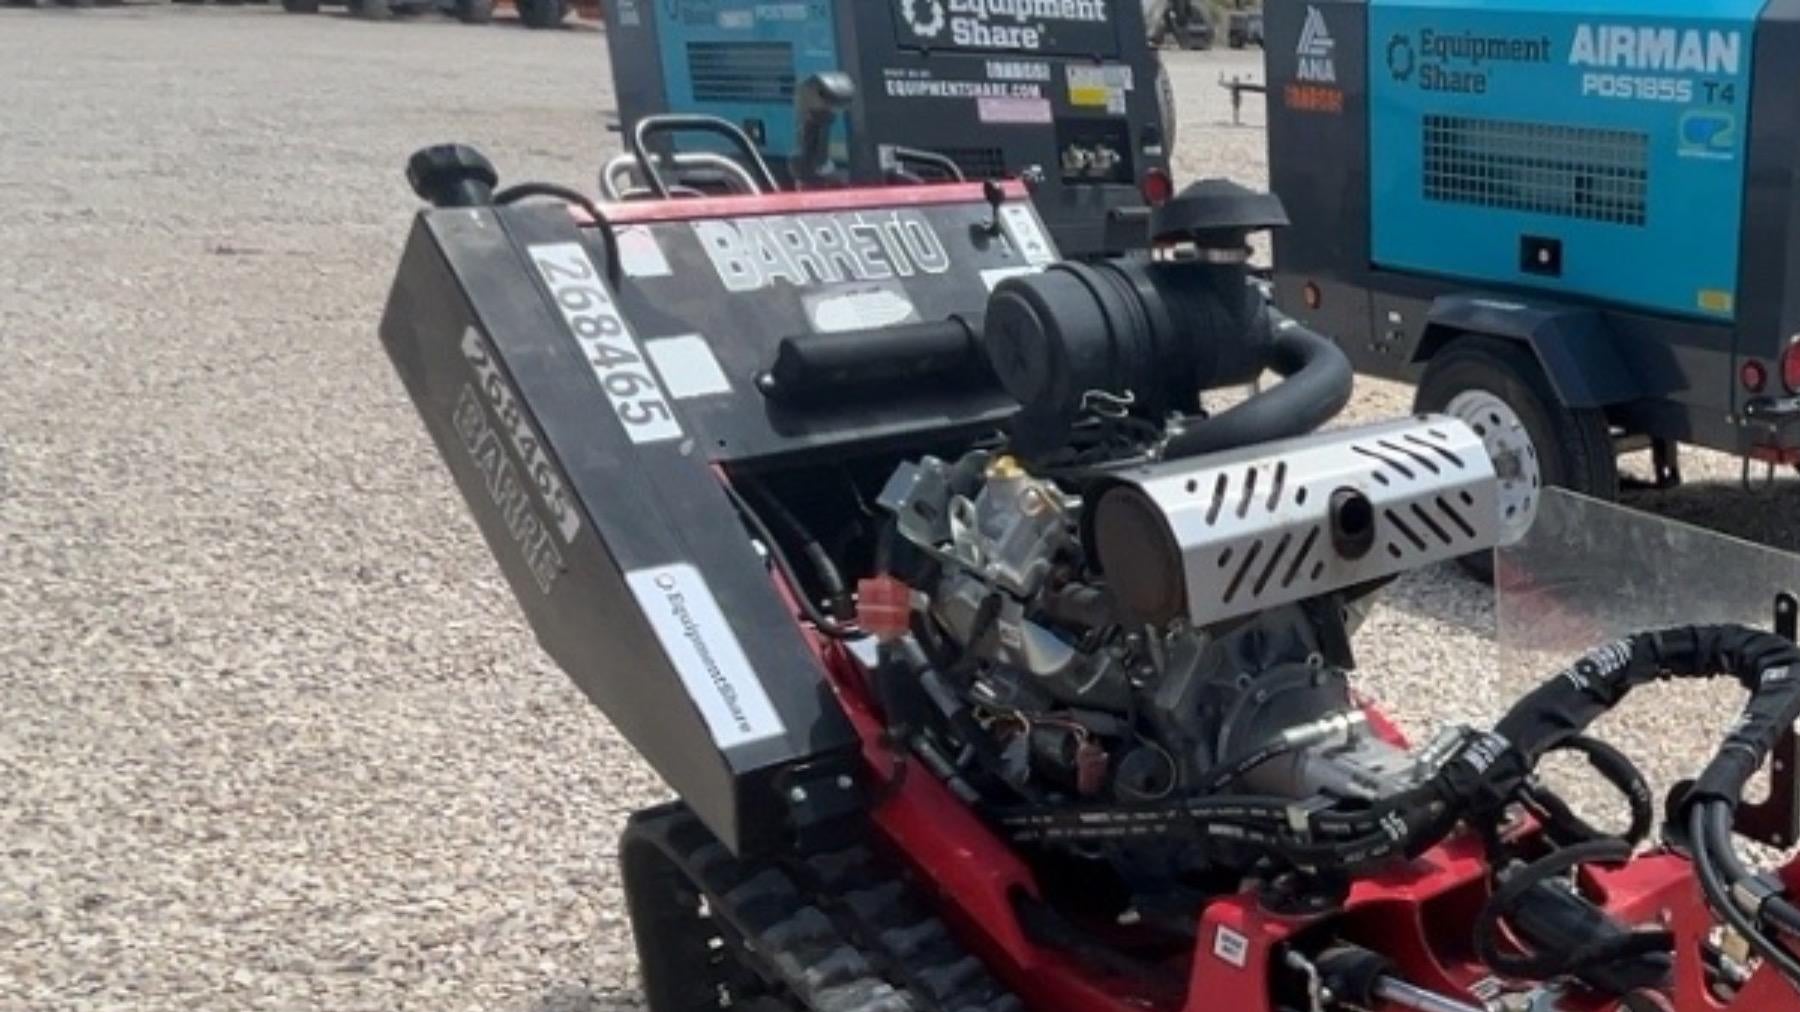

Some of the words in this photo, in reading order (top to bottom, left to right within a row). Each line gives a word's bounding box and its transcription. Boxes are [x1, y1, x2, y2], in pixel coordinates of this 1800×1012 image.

[952, 17, 1040, 48] Share
[1419, 28, 1551, 64] Equipment
[1568, 23, 1741, 74] AIRMAN
[1296, 58, 1336, 82] ANA
[1418, 64, 1487, 94] Share
[1703, 81, 1735, 104] T4
[690, 209, 949, 292] BARRETO
[537, 255, 673, 427] 268465
[667, 592, 752, 734] EquipmentShare
